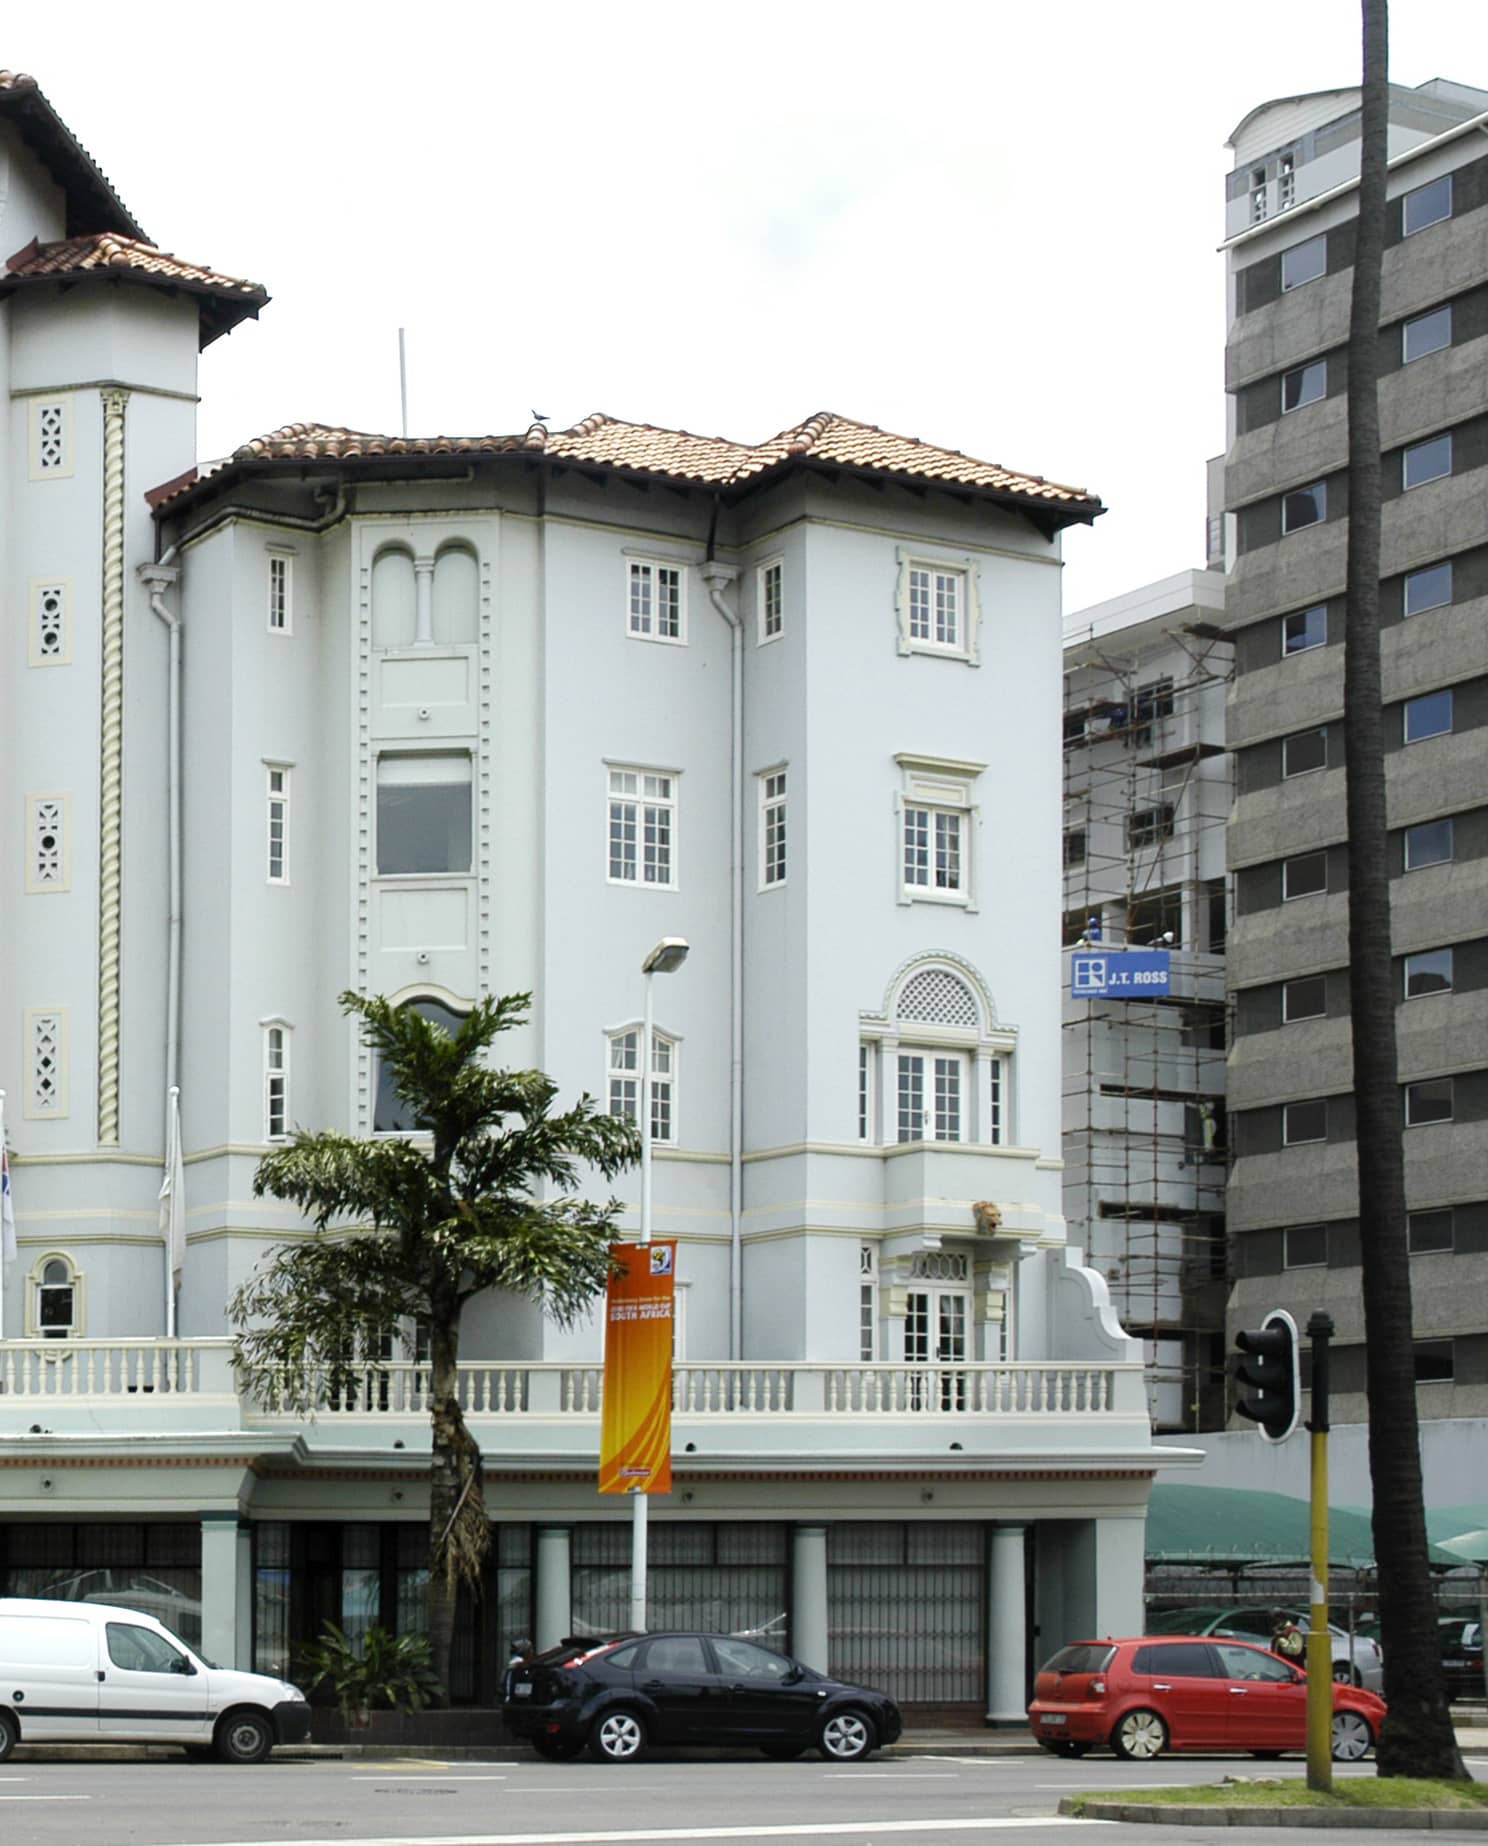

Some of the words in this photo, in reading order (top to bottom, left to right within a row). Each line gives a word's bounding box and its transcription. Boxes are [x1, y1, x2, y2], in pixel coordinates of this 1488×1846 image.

[1108, 972, 1130, 985] J.T.
[1133, 970, 1168, 985] ROSS
[611, 1311, 637, 1321] SOUTH
[639, 1309, 671, 1320] AFRICA
